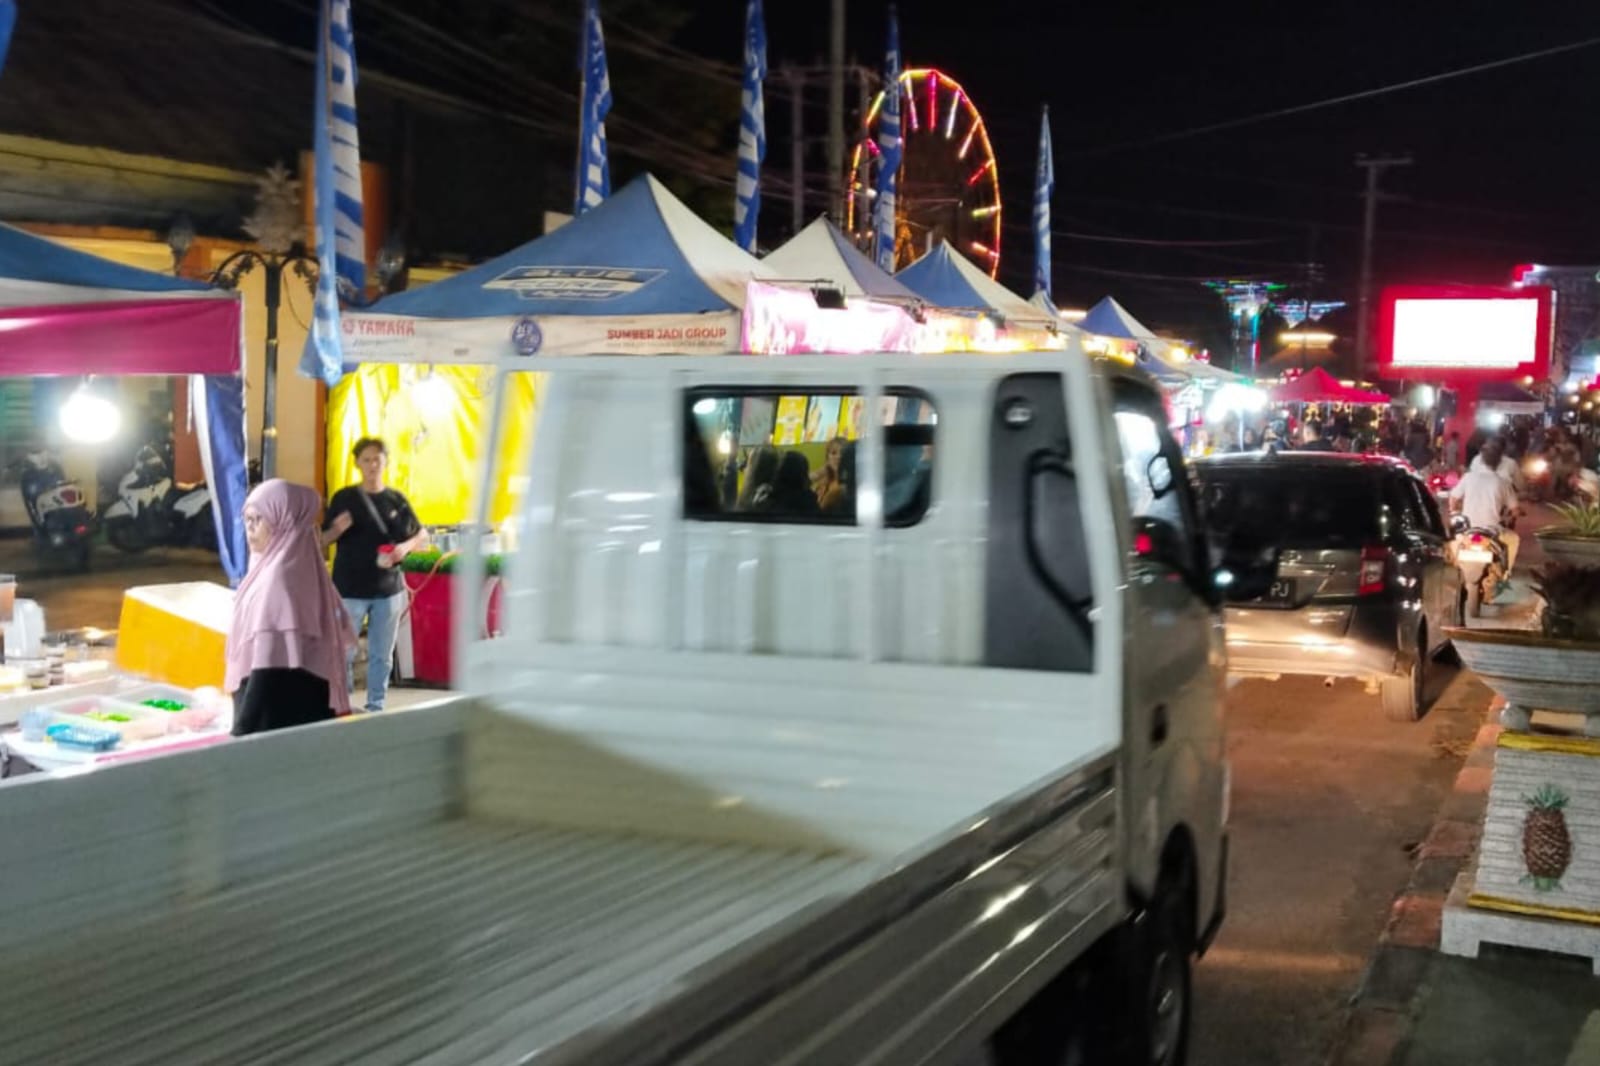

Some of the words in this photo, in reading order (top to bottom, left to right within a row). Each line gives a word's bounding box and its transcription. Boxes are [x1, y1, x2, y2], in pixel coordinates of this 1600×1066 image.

[358, 319, 416, 336] YAMAHA
[607, 329, 655, 340] SUMBER
[656, 328, 684, 339] JADI
[685, 327, 727, 339] GROUP
